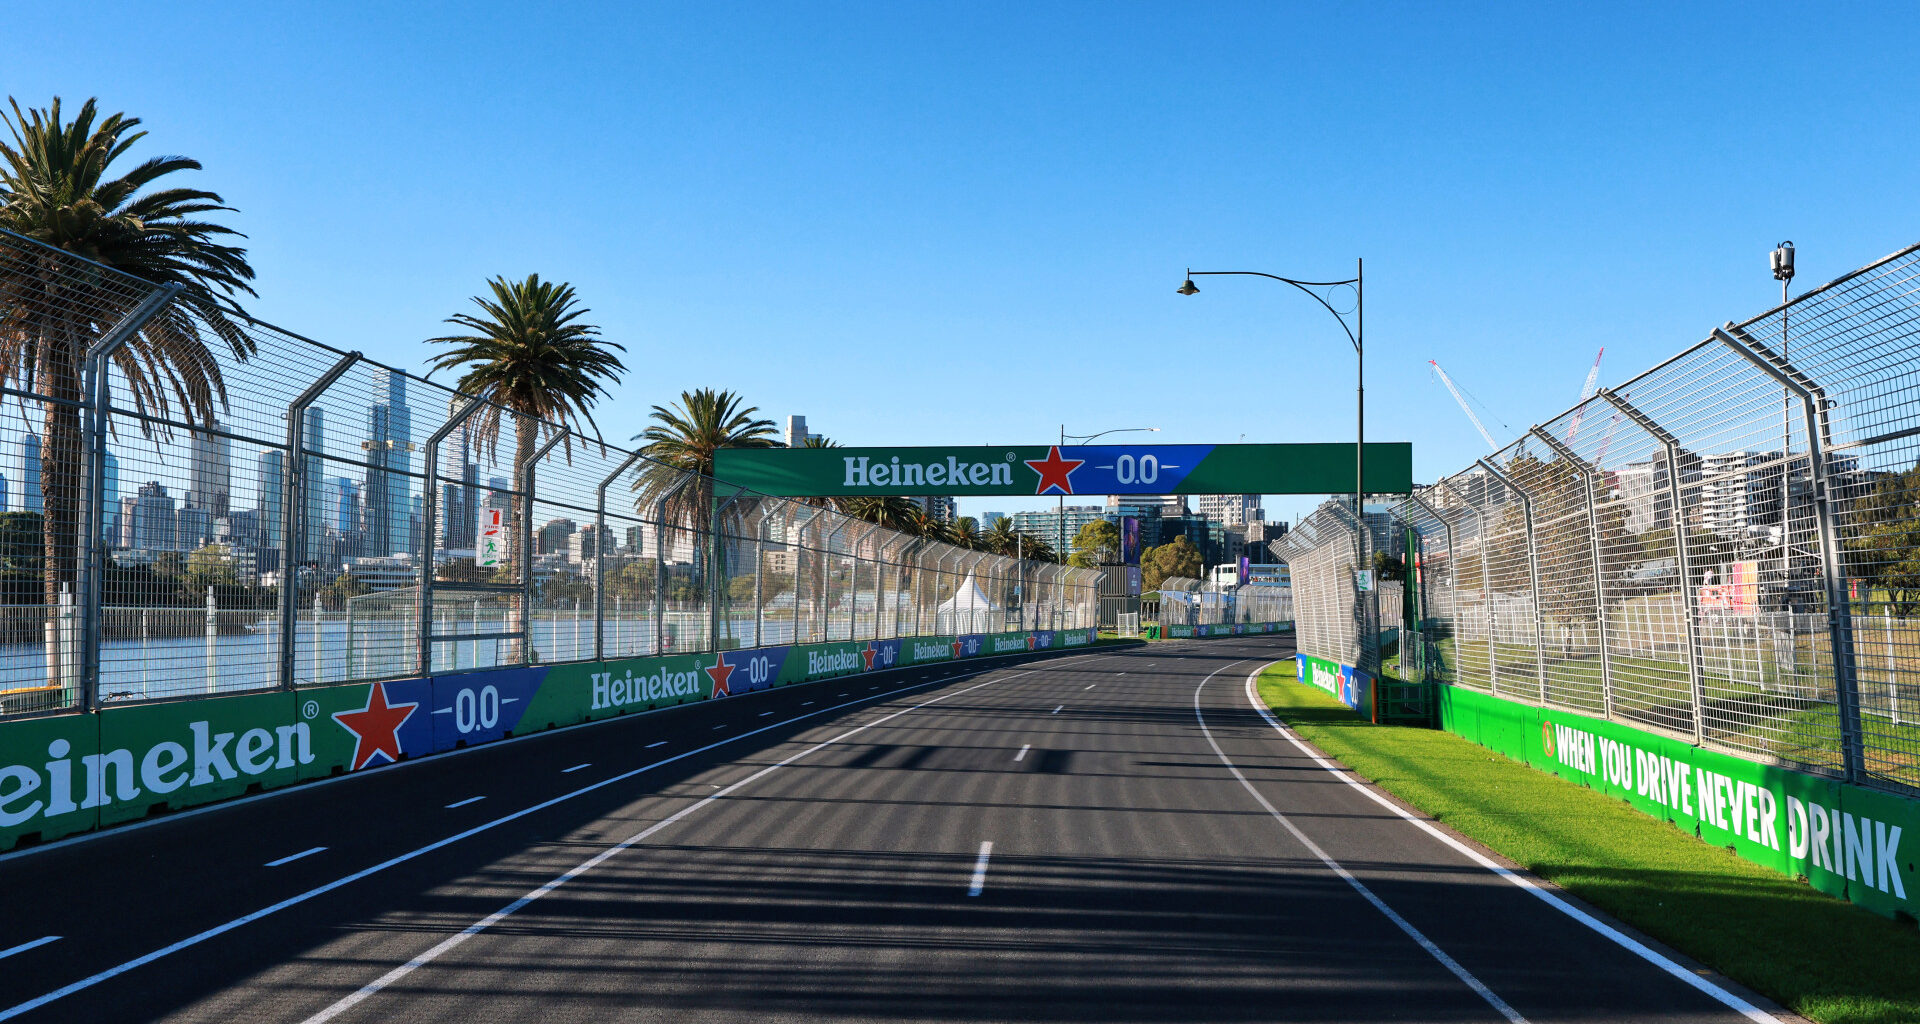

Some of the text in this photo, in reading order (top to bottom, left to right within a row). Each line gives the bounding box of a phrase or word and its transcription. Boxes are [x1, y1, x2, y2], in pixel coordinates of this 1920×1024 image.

[1116, 454, 1159, 485] 0.0
[808, 647, 859, 675] Heineken
[914, 641, 950, 660] Heineken
[591, 665, 700, 710] Heineken
[456, 684, 499, 734] 0.0
[1555, 723, 1908, 901] WHEN YOU DRIVE NEVER DRINK
